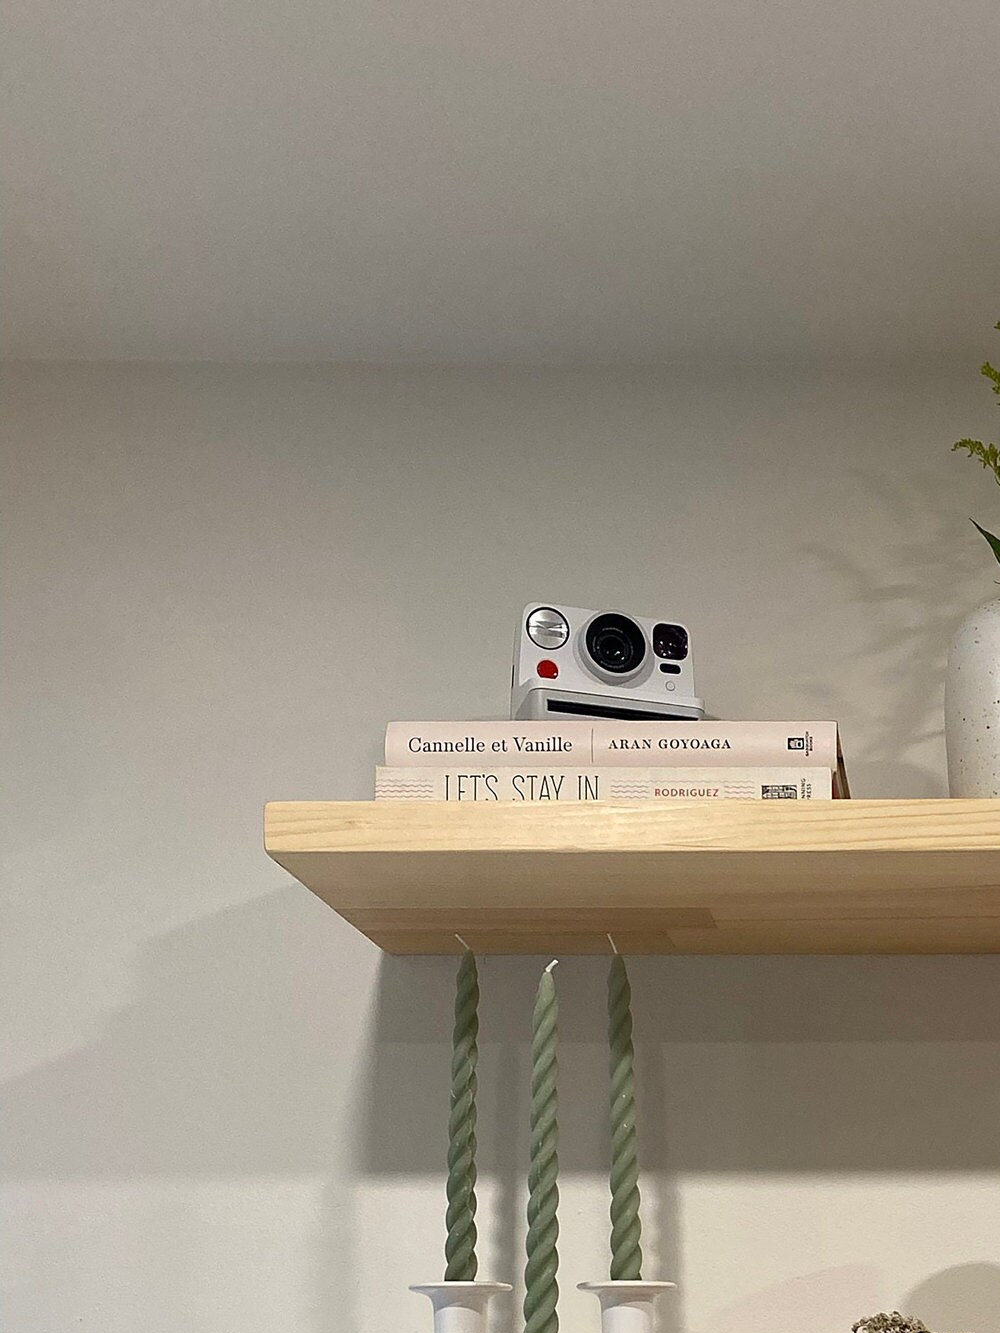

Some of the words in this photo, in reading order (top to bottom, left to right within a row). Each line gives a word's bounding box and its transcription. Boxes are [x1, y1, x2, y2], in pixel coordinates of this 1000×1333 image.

[408, 736, 486, 753] Cannelle
[491, 738, 508, 753] et
[512, 736, 573, 753] Vanille
[608, 738, 652, 750] ARAN
[658, 738, 732, 750] GOYOAGA
[444, 773, 499, 801] LET'S
[511, 774, 566, 801] STAY
[577, 775, 600, 801] IN
[654, 788, 719, 798] RODRIGUEZ
